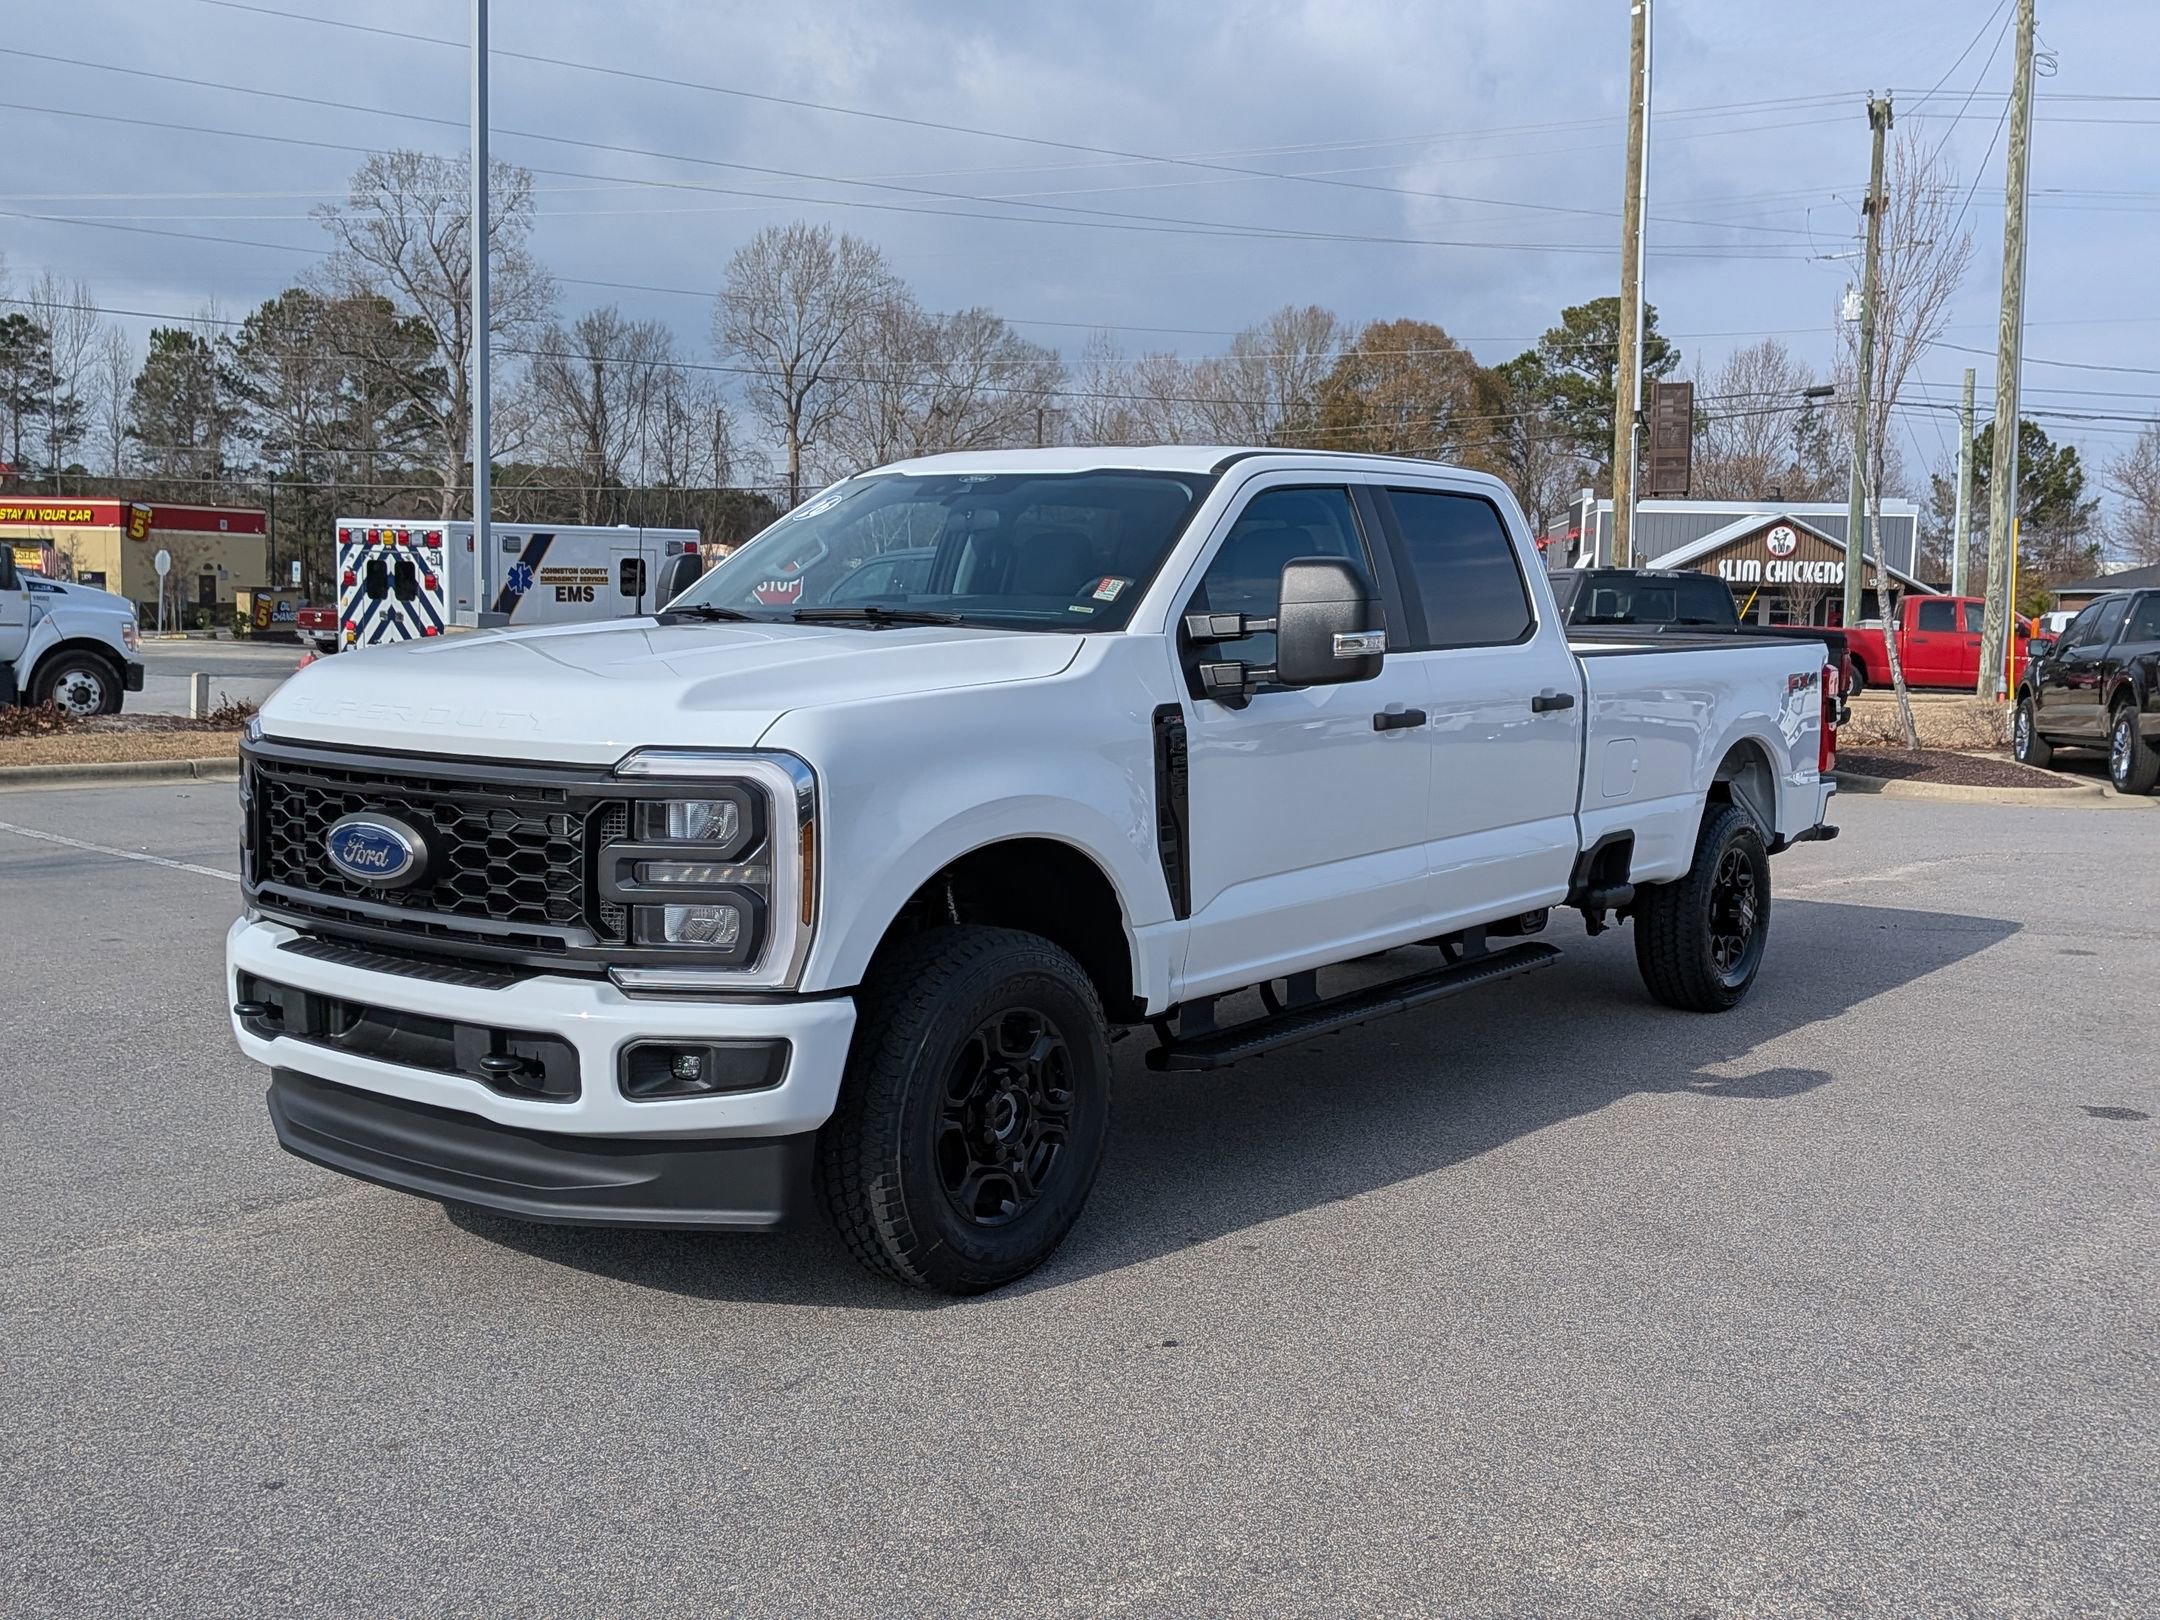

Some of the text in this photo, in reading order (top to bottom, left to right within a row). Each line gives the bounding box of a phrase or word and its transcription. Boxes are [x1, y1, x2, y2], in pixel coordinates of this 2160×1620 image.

[0, 508, 92, 521] STAY IN YOUR CAR
[131, 518, 144, 538] 5
[541, 567, 608, 575] JOHNSTON COUNTY
[1718, 559, 1844, 584] SLIM CHICKENS
[555, 585, 595, 602] EMS
[257, 608, 267, 626] 5
[343, 833, 391, 868] Ford
